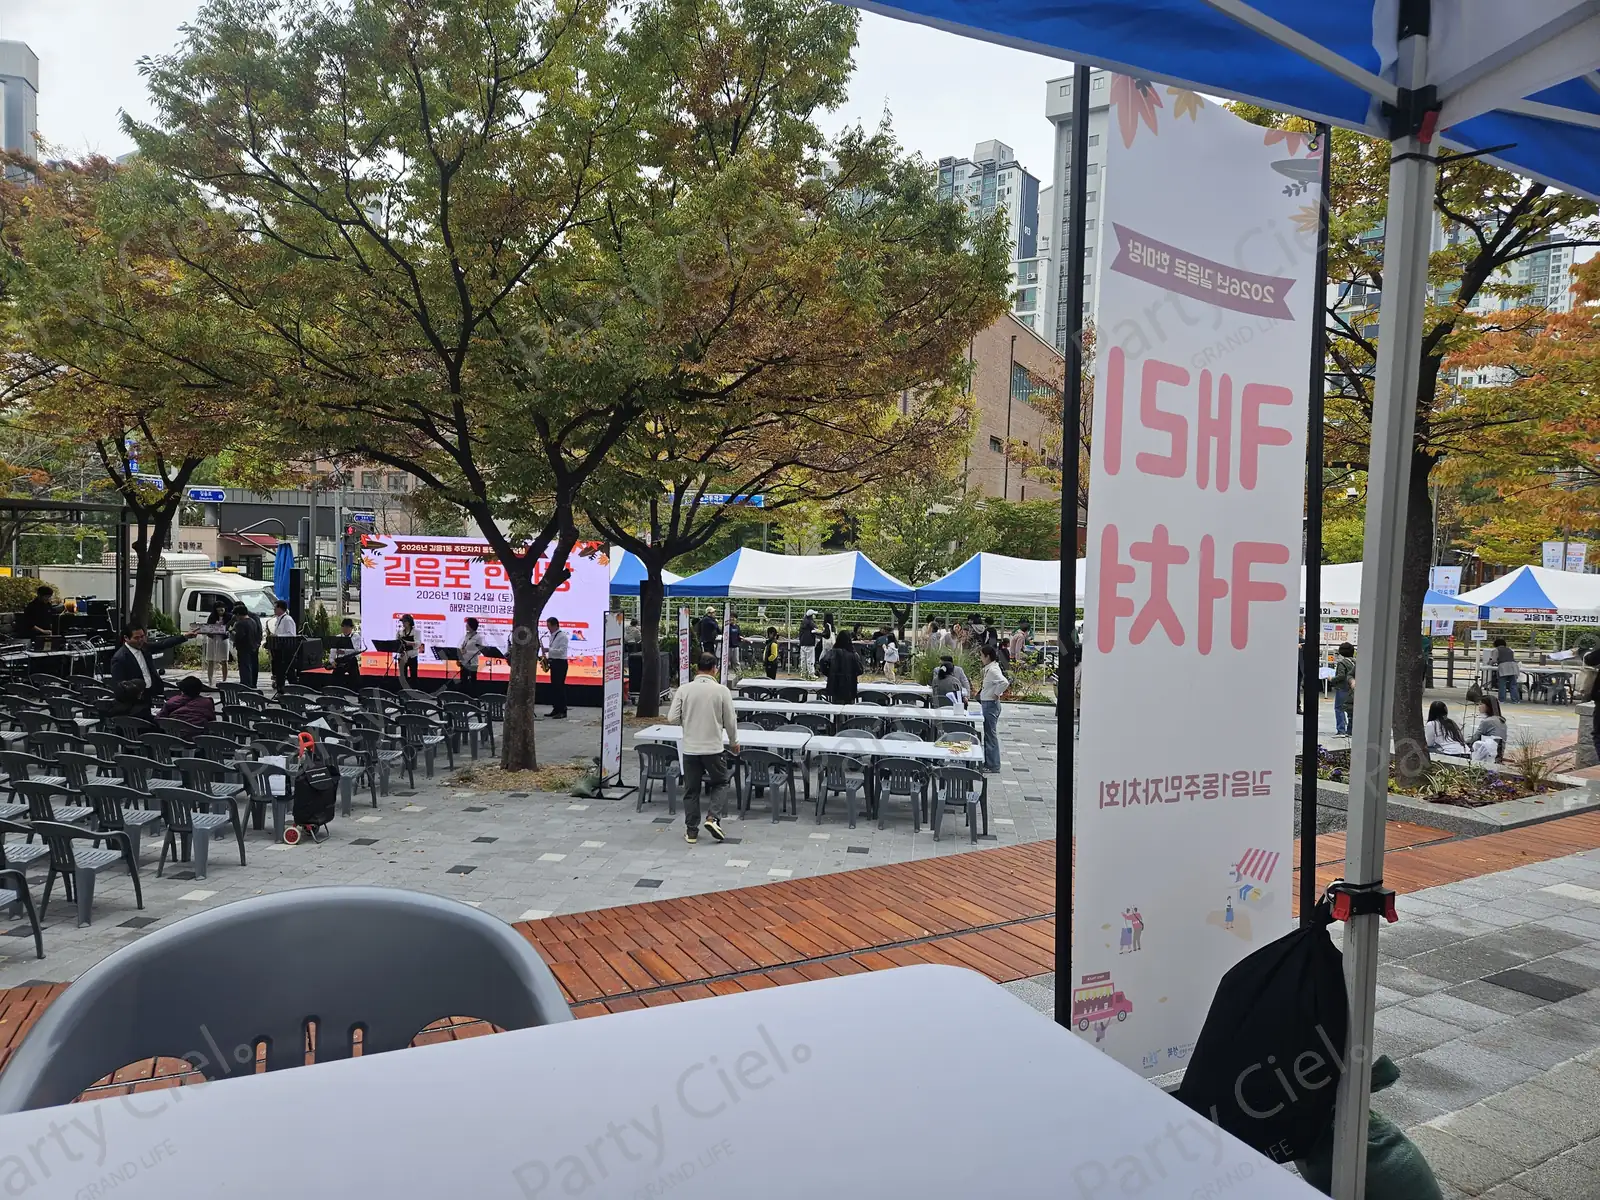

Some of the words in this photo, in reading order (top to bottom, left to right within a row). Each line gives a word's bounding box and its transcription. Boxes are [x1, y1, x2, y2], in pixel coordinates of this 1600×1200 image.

[401, 544, 428, 552] 2026년
[429, 545, 452, 553] 길음1동
[454, 545, 480, 553] 주민자치
[383, 556, 472, 588] 길음로
[416, 591, 449, 600] 2026년
[452, 592, 471, 601] 10월
[474, 593, 495, 602] 24일
[1556, 614, 1599, 623] 주민자치회
